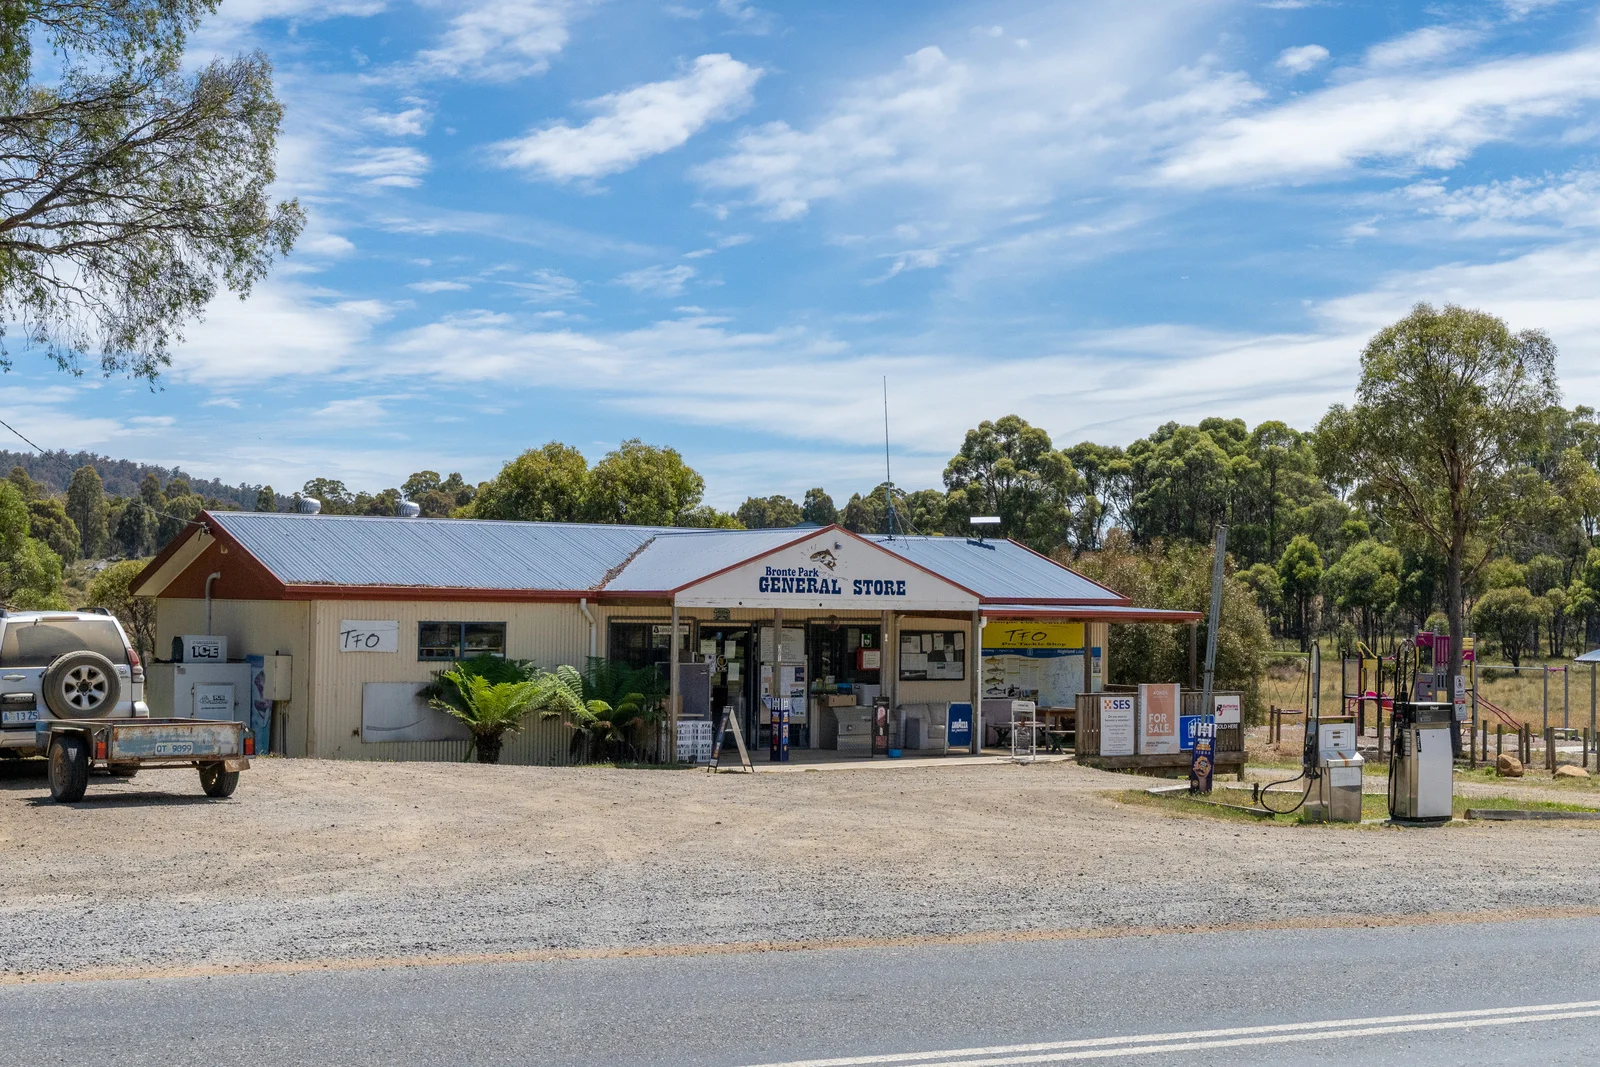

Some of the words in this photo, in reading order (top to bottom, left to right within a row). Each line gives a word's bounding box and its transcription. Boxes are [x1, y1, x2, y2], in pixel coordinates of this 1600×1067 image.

[765, 566, 796, 577] Bronte
[798, 567, 819, 577] Park
[759, 577, 842, 595] GENERAL
[853, 579, 906, 596] STORE
[340, 629, 380, 648] TFO
[1005, 629, 1047, 641] TFO
[192, 645, 219, 658] ICE
[1113, 699, 1131, 709] SES
[1149, 713, 1167, 723] FOR
[1148, 723, 1172, 733] SALE.
